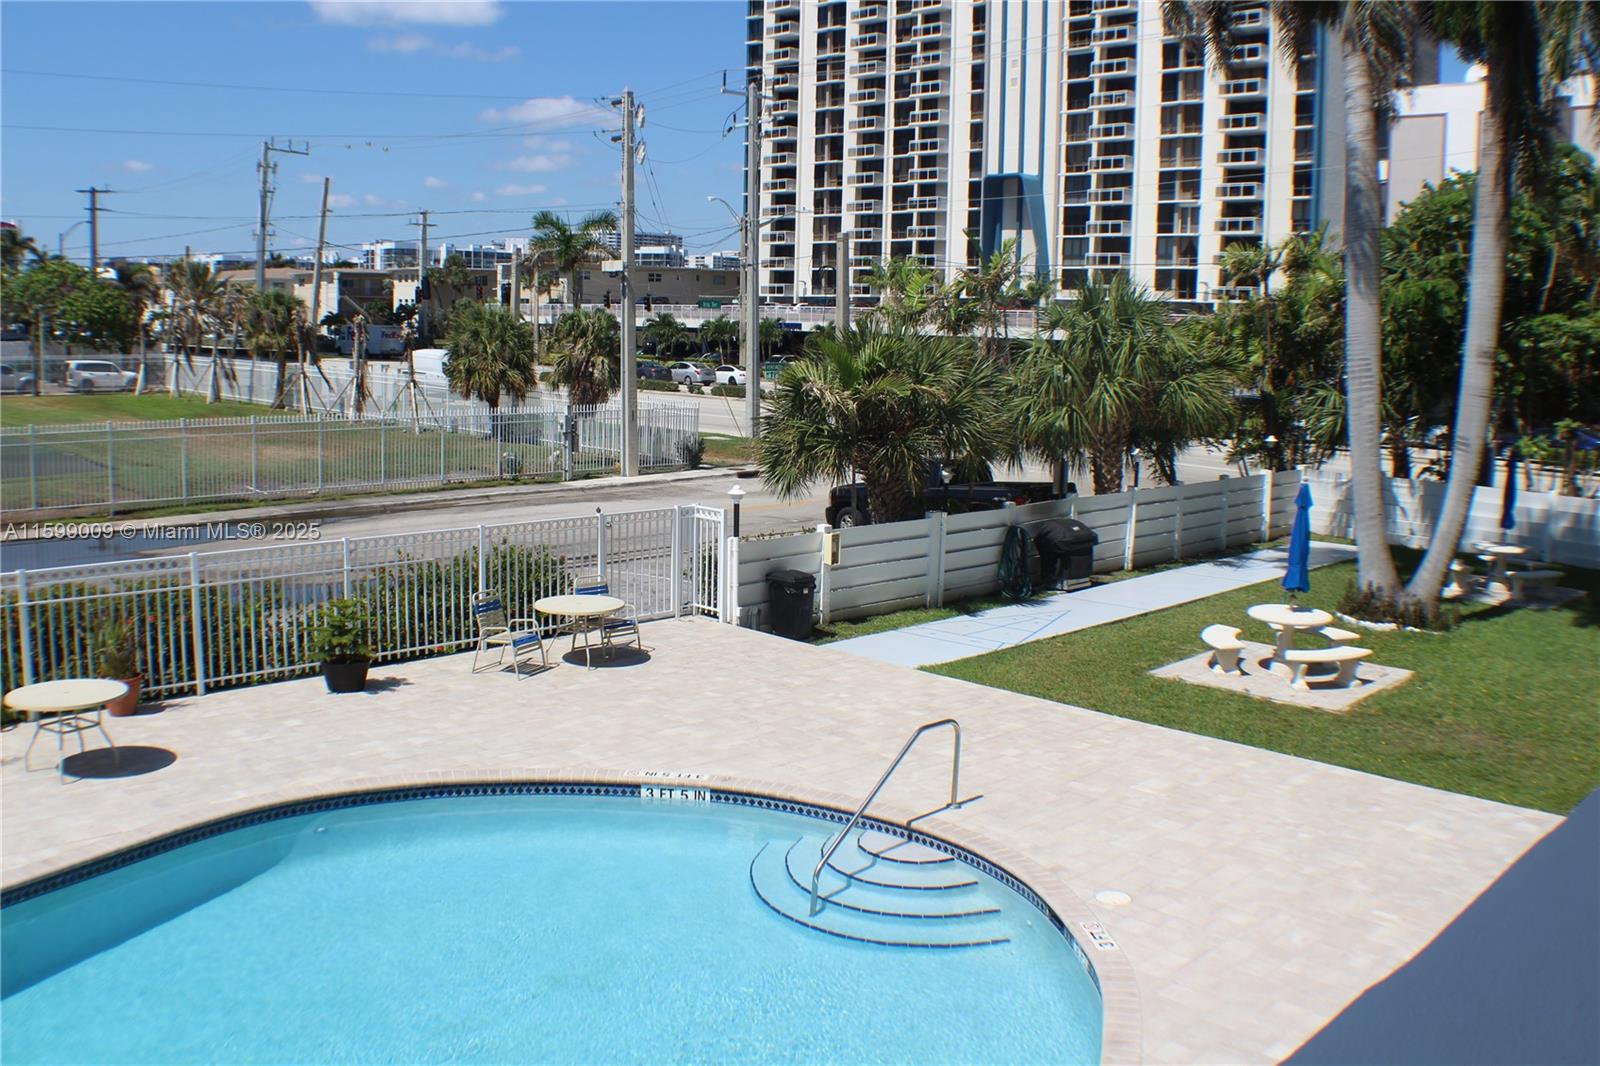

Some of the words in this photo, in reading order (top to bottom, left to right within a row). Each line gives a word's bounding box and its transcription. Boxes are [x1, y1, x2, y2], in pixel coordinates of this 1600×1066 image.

[646, 787, 654, 798] 3
[660, 788, 674, 799] FT
[681, 789, 689, 800] 5
[694, 790, 706, 801] IN
